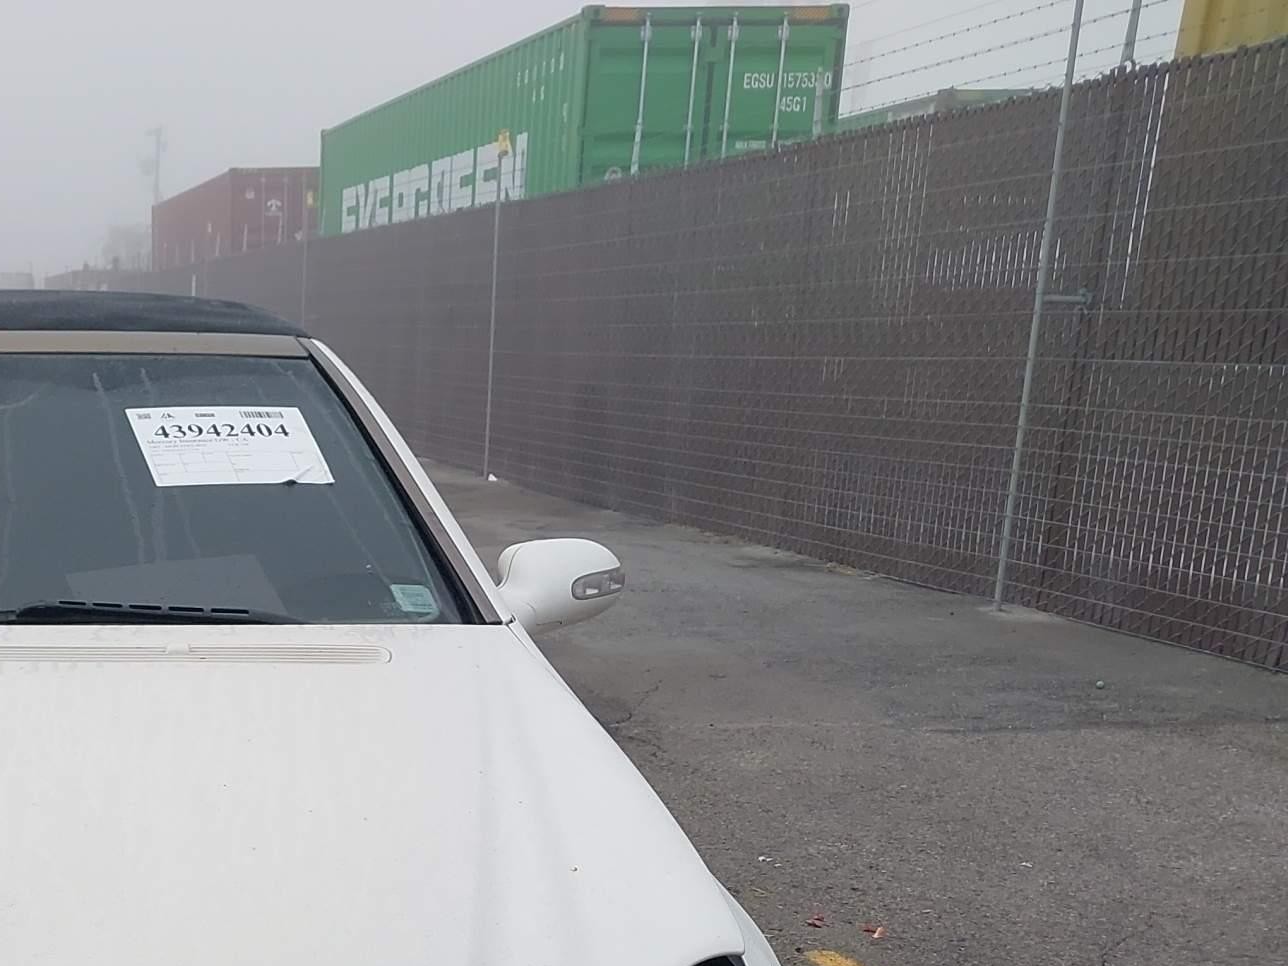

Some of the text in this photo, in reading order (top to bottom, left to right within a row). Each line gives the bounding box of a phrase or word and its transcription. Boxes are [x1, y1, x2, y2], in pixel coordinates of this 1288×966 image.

[743, 71, 775, 89] EGSU
[780, 96, 807, 112] 45G1
[342, 132, 529, 234] EVERGREEN
[154, 423, 290, 438] 43942404
